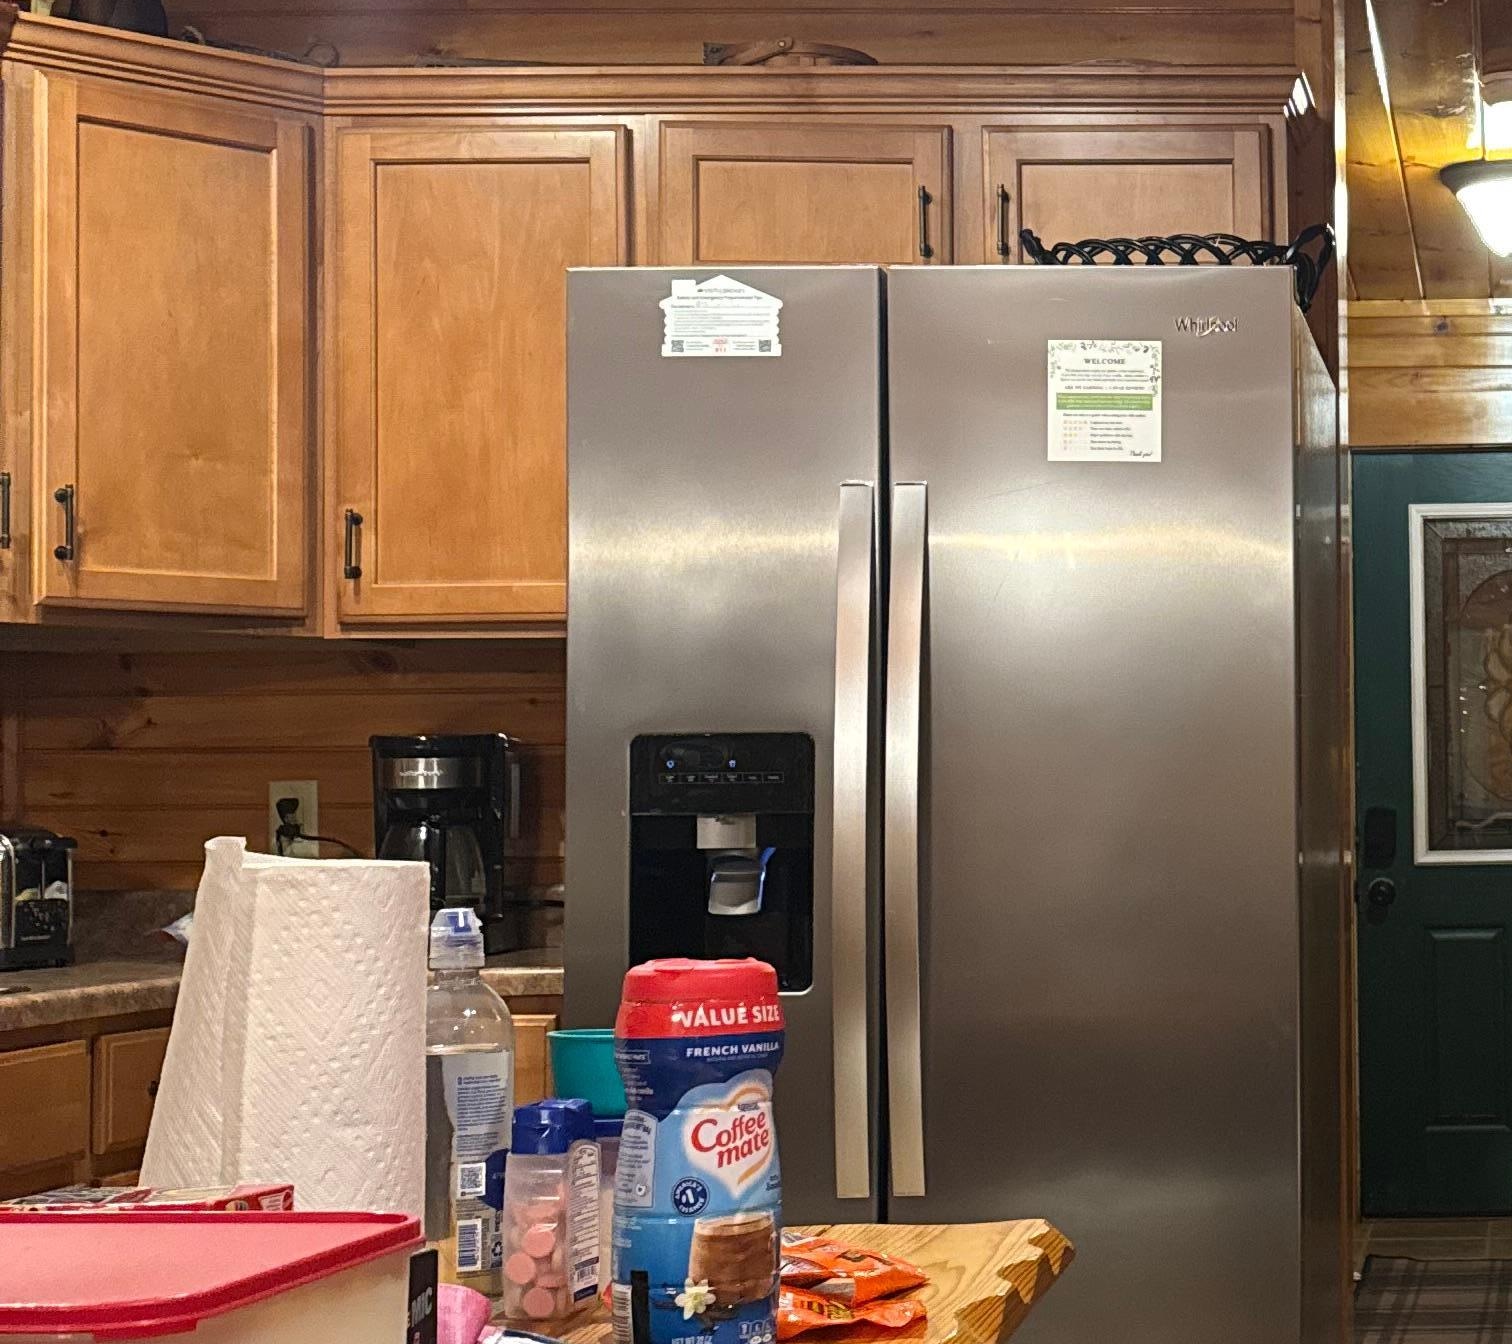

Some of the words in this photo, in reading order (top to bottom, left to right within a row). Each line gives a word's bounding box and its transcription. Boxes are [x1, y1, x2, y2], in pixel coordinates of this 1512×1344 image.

[680, 1003, 748, 1028] VALUE
[752, 1003, 780, 1023] SIZE
[686, 1042, 739, 1057] FRENCH
[741, 1041, 779, 1053] VANILLA
[691, 1111, 766, 1153] Coffee
[717, 1128, 769, 1168] mate
